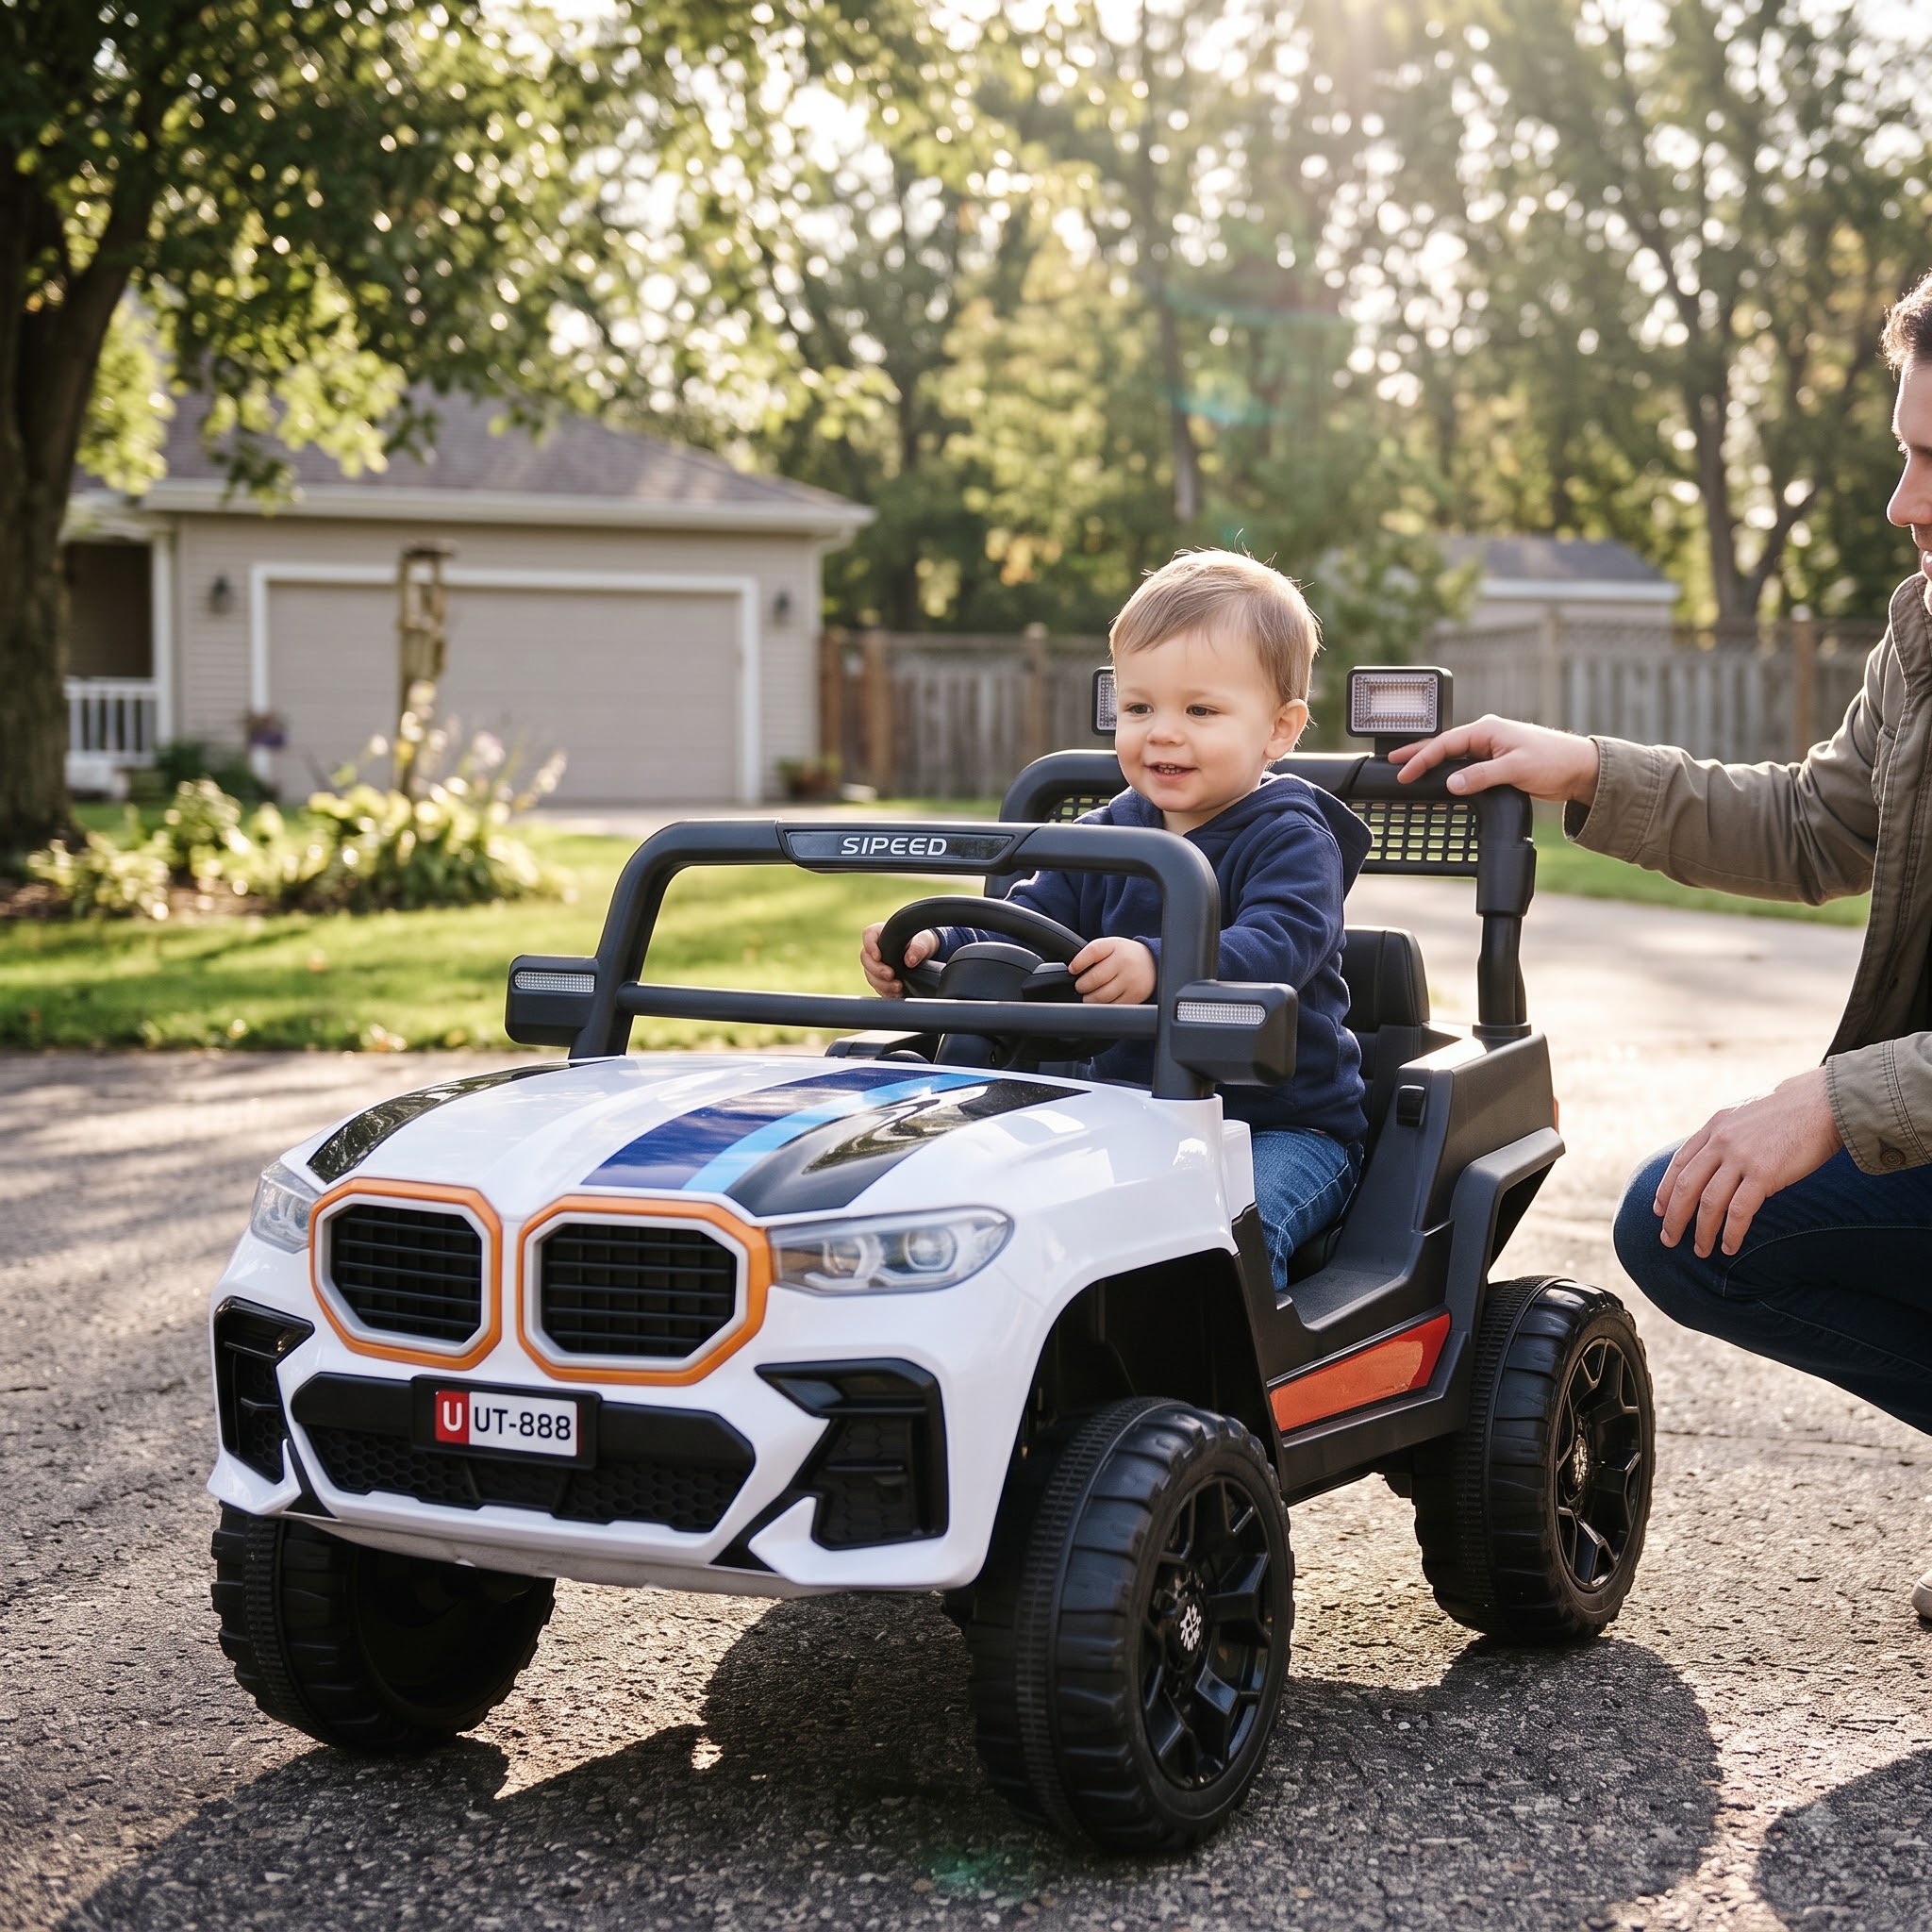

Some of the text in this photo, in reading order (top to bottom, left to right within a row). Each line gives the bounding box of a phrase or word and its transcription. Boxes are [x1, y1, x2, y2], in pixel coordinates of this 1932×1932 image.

[841, 837, 948, 856] SIPEED
[442, 1400, 571, 1441] U UT-888
